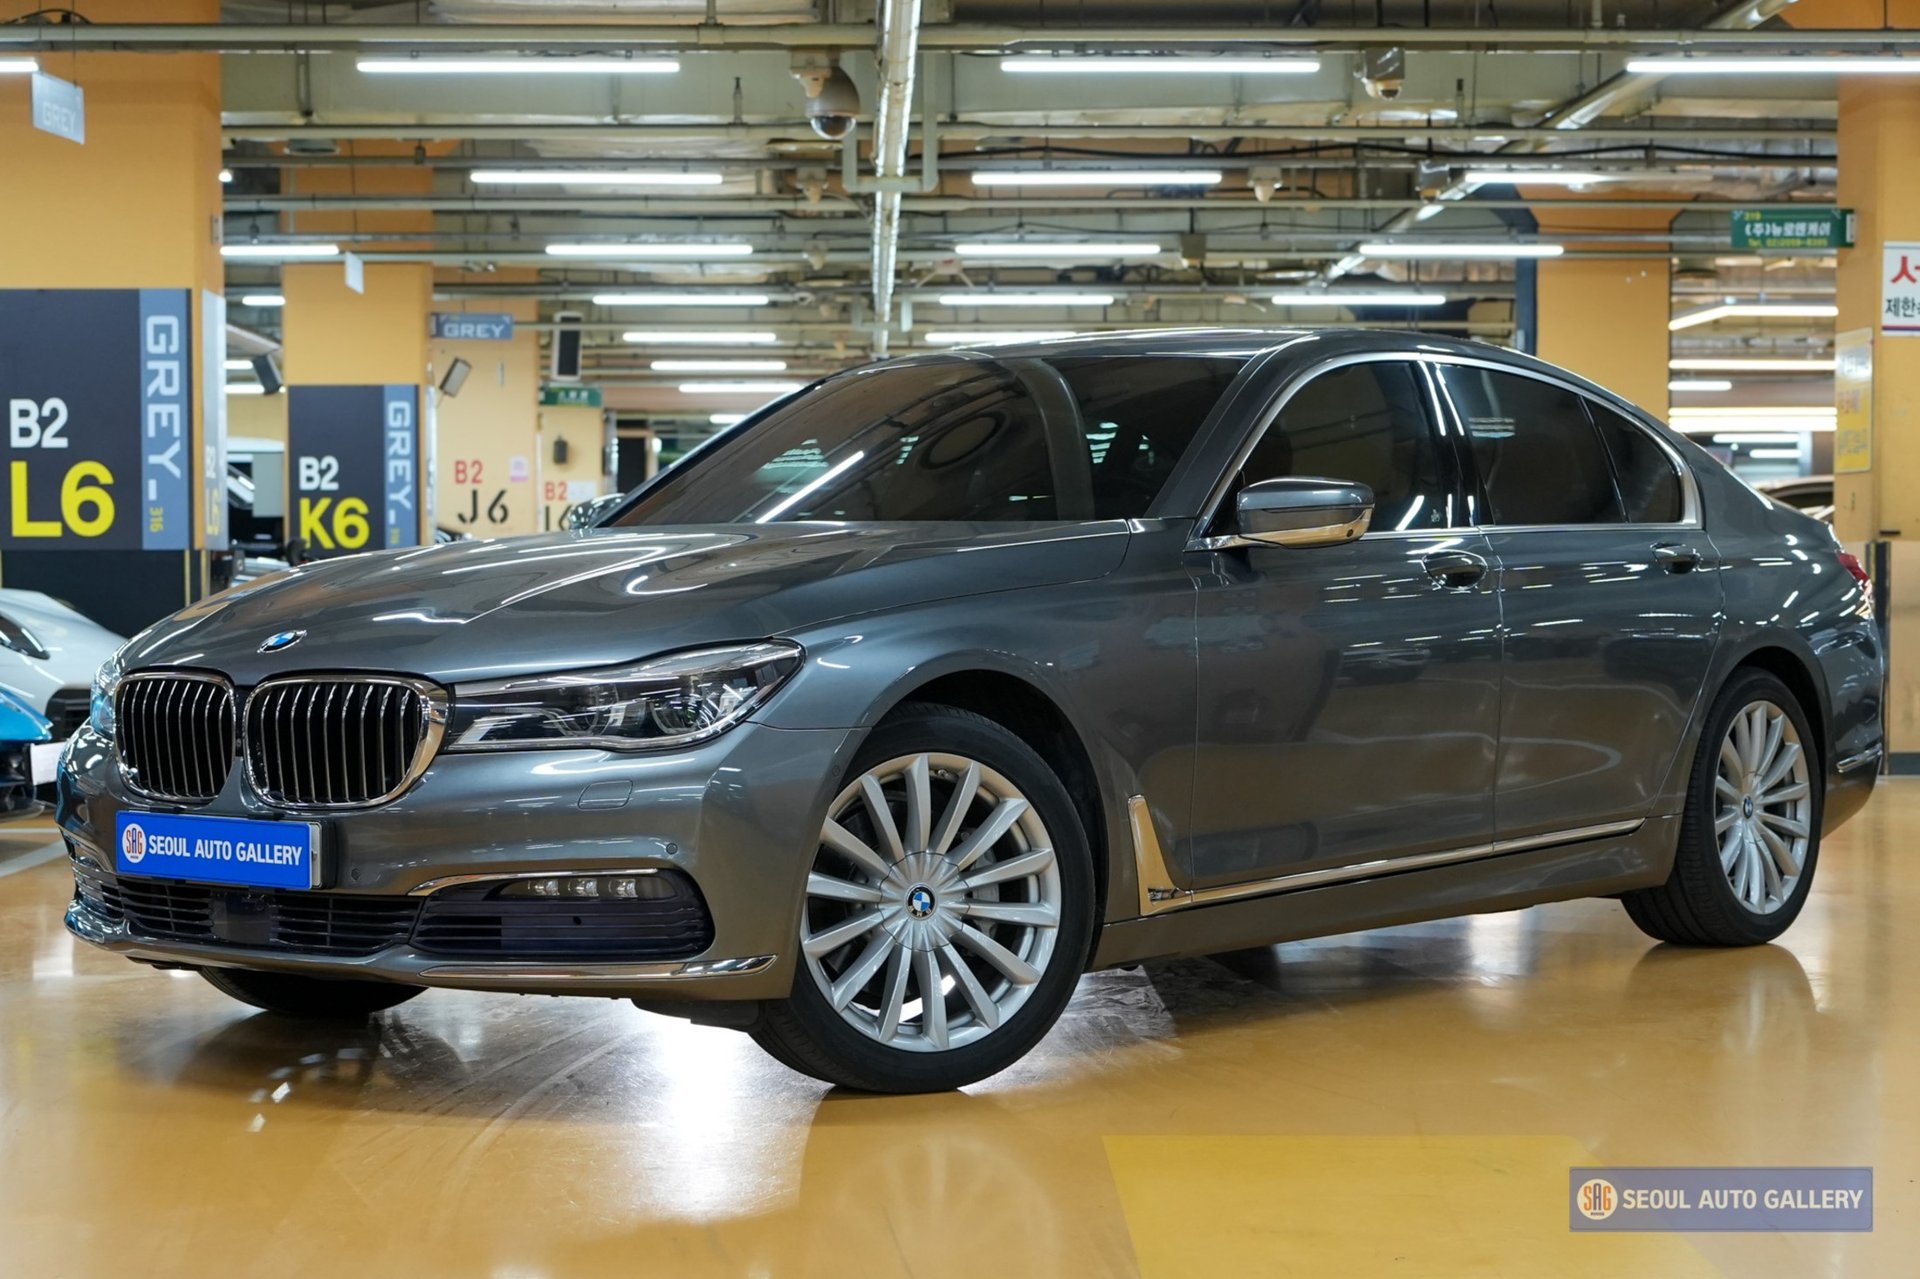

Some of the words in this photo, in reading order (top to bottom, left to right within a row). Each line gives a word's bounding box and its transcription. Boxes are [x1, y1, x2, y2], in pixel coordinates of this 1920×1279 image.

[42, 101, 76, 133] GREY
[443, 323, 504, 338] GREY
[10, 397, 69, 449] B2
[298, 455, 340, 491] B2
[455, 460, 484, 484] B2
[11, 460, 115, 538] L6
[457, 489, 508, 524] J6
[545, 481, 567, 501] B2
[299, 496, 370, 549] K6
[125, 827, 143, 855] SAG
[148, 834, 190, 858] SEOUL
[194, 838, 232, 861] AUTO
[236, 842, 303, 866] GALLERY
